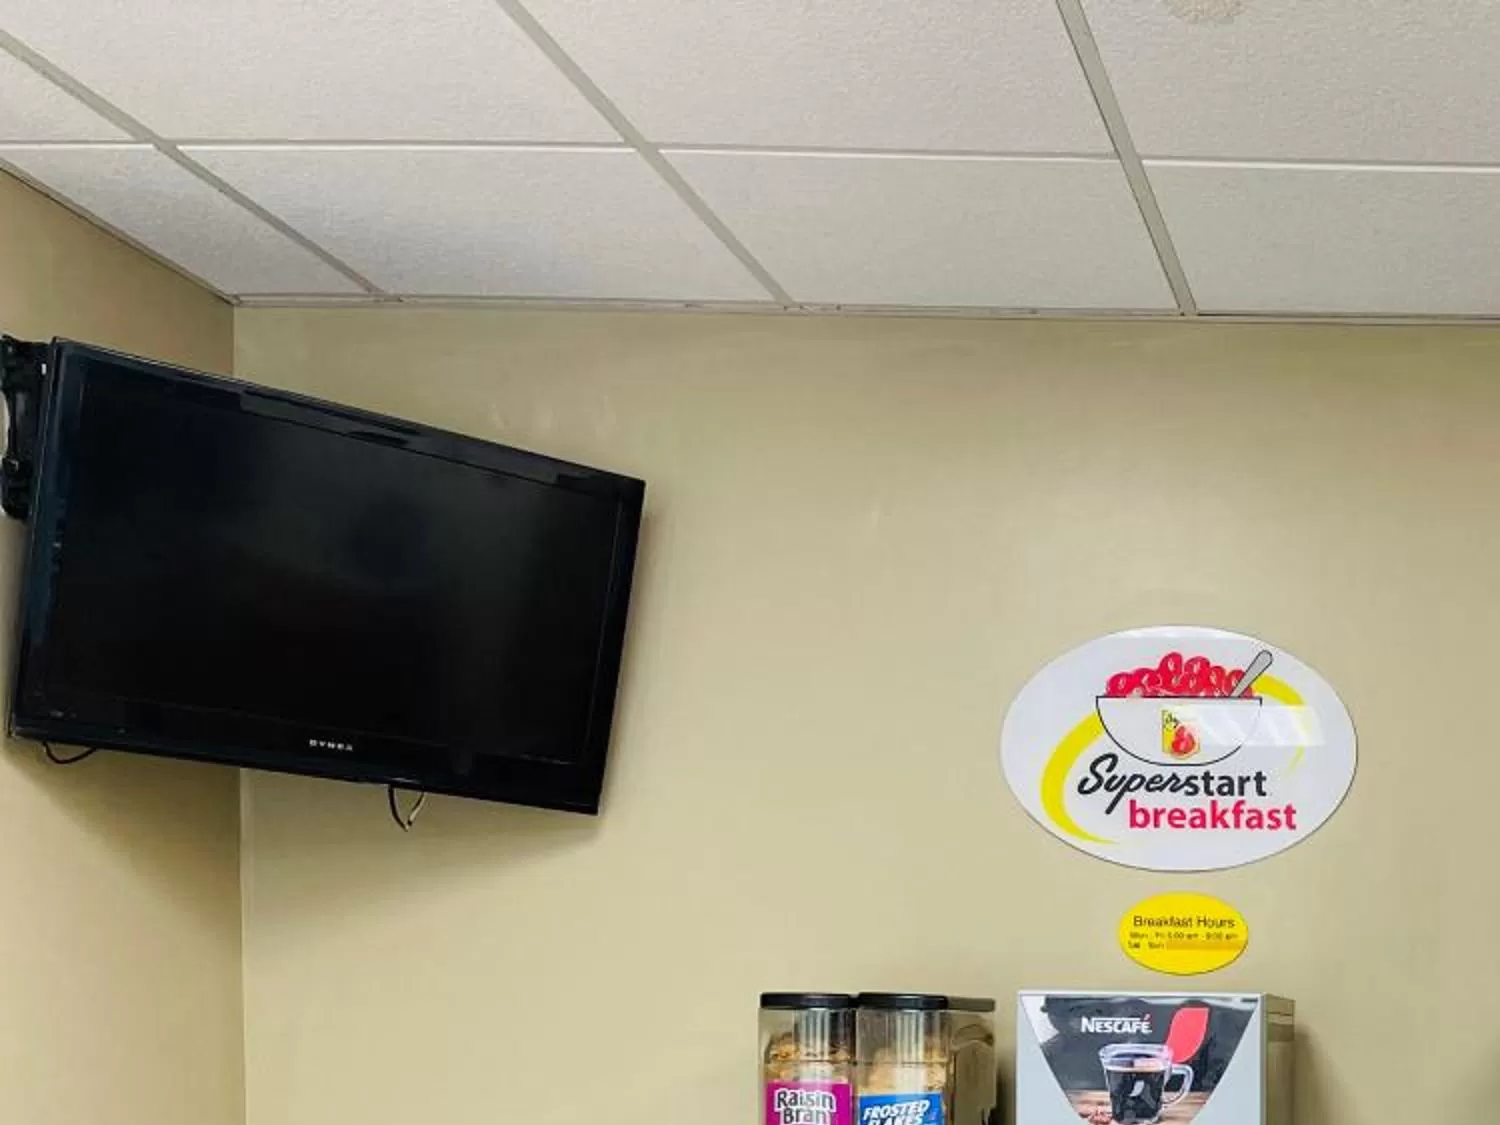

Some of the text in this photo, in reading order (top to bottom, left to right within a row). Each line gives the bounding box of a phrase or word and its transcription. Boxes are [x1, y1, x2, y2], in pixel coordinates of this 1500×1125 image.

[1077, 753, 1267, 815] Superstart
[1129, 799, 1297, 830] breakfast
[1133, 915, 1236, 928] Breakfast Hours
[776, 1089, 835, 1112] Raisin
[863, 1099, 931, 1121] FROSTED
